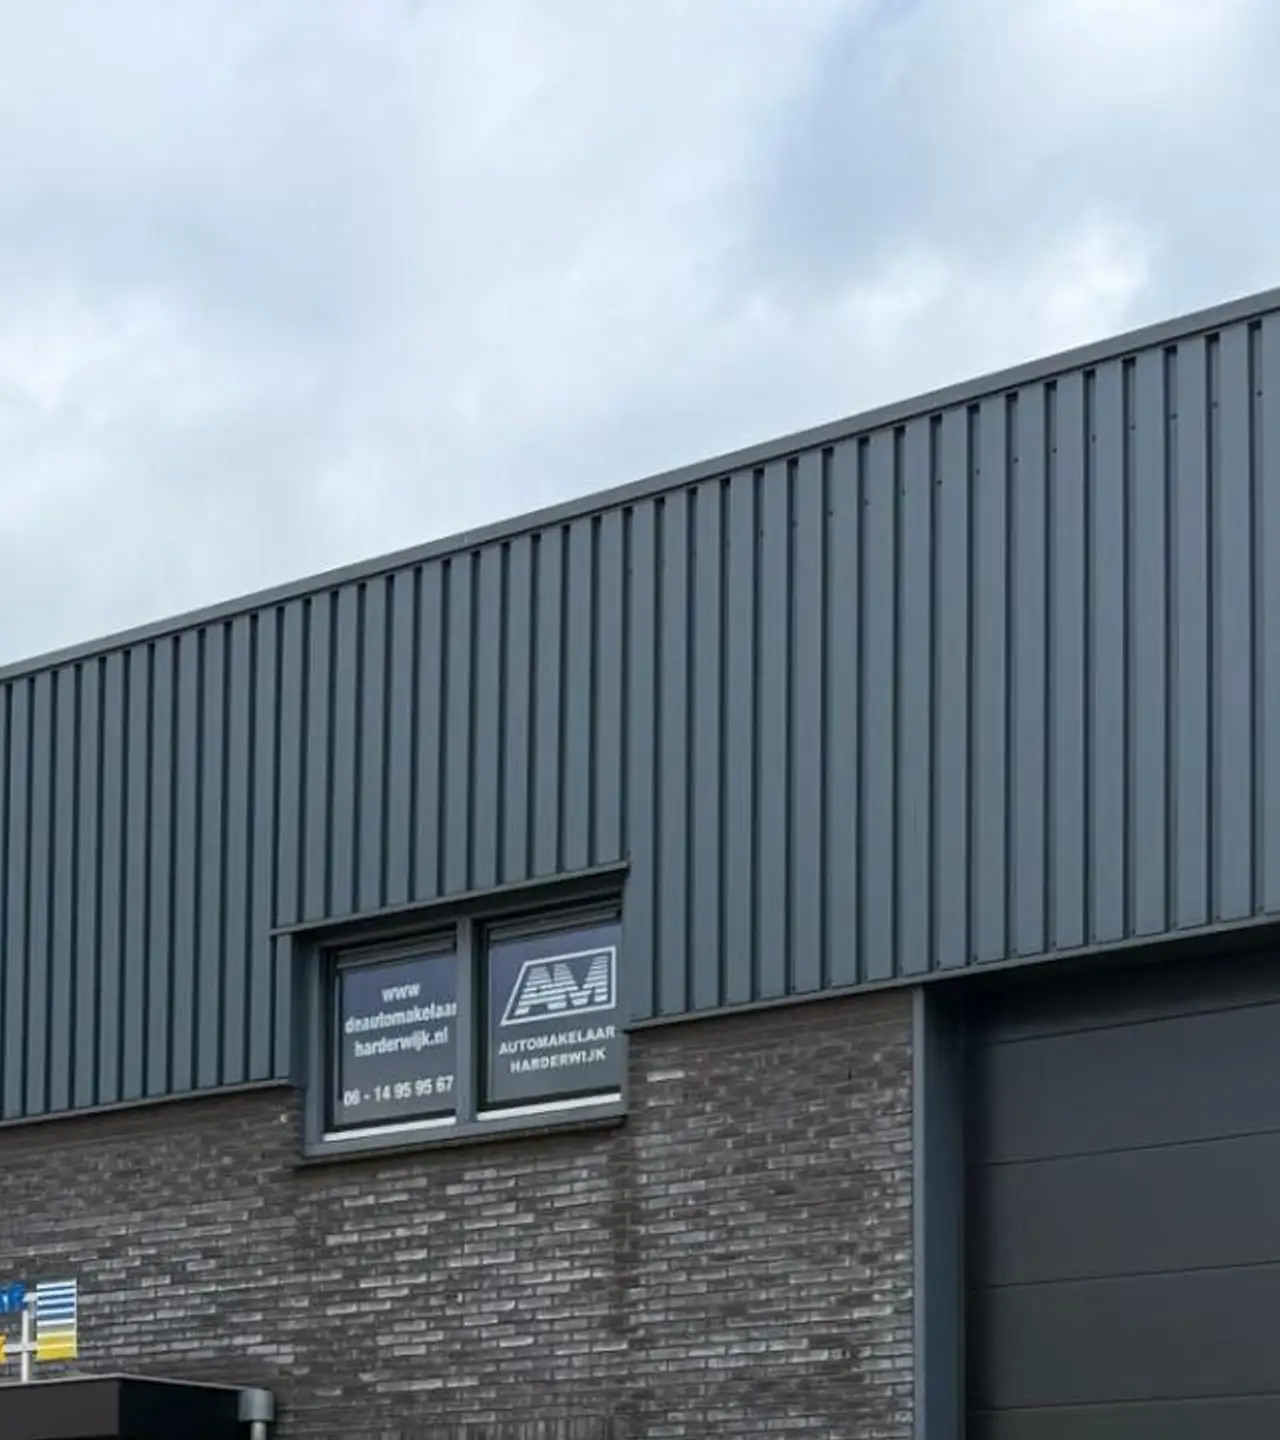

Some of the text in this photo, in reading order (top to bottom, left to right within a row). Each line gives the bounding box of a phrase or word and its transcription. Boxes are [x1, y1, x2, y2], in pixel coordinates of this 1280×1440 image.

[354, 1026, 449, 1057] harderwijk.nl
[499, 1025, 616, 1055] AUTOMAKELAAR
[510, 1047, 607, 1073] HARDERWIJK
[374, 1084, 391, 1103] 14
[394, 1081, 412, 1100] 95
[415, 1078, 433, 1097] 95
